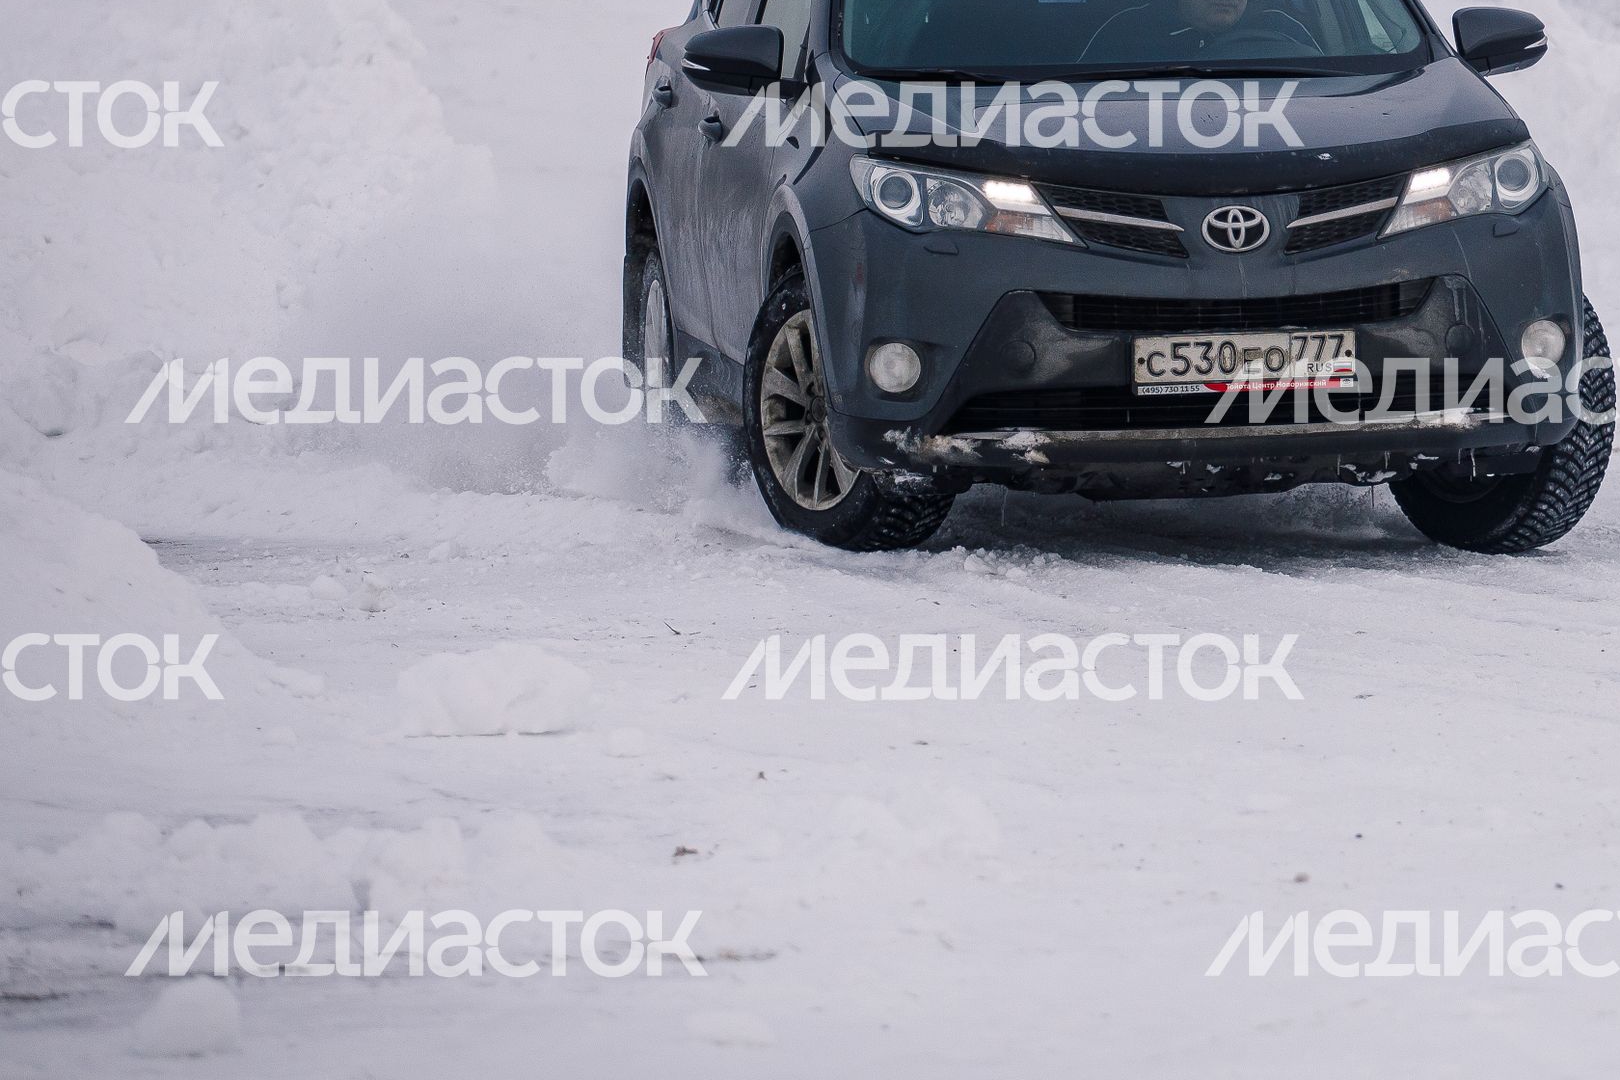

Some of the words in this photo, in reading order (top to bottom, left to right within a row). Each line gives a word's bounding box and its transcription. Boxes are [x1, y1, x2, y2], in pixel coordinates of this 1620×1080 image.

[1292, 334, 1345, 361] 777
[1307, 363, 1332, 373] RUS
[1142, 385, 1164, 394] (495)
[1164, 385, 1179, 393] 730
[1190, 384, 1200, 392] 55
[1226, 382, 1251, 391] Тойота
[1252, 381, 1275, 390] Центр
